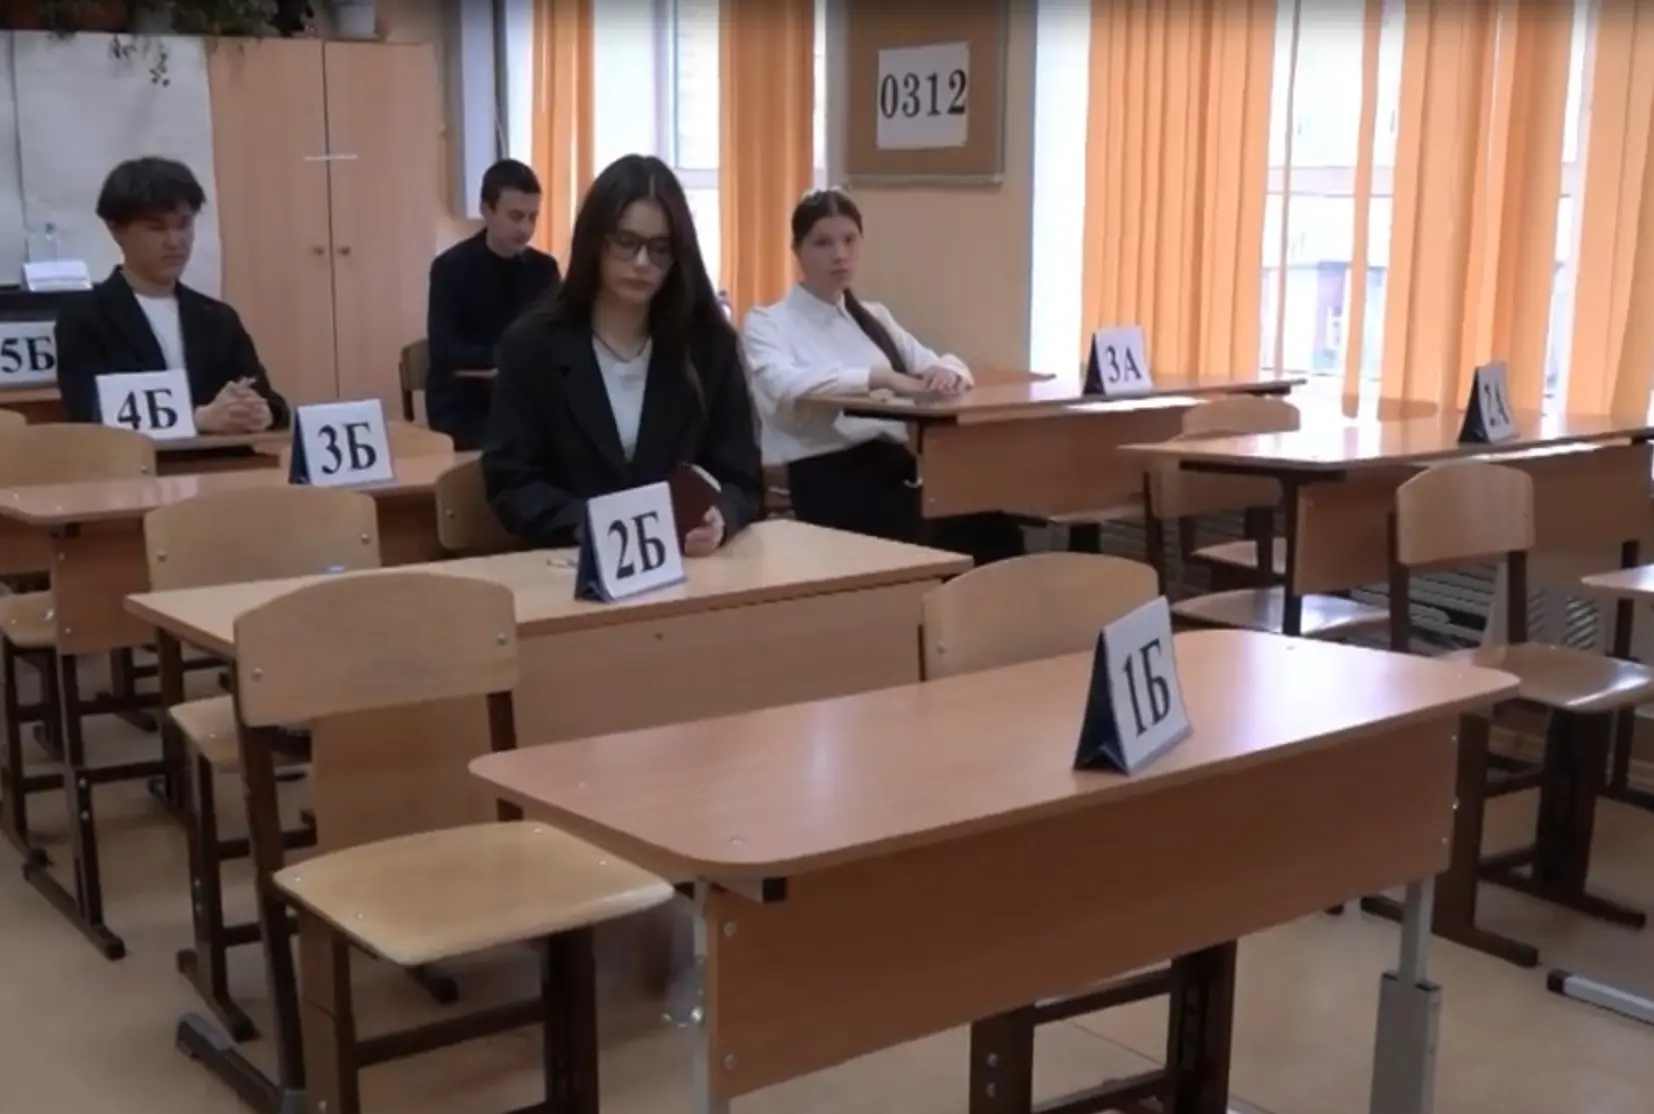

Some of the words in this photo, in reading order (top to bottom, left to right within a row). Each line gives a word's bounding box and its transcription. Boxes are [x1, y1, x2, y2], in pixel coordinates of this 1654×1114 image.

[880, 69, 966, 118] 0312
[1, 336, 55, 373] 5Б
[1106, 345, 1142, 383] 3А
[117, 388, 178, 430] 4Б
[318, 421, 377, 475] 3Б
[608, 511, 666, 581] 2Б
[1123, 638, 1170, 738] 1Б
